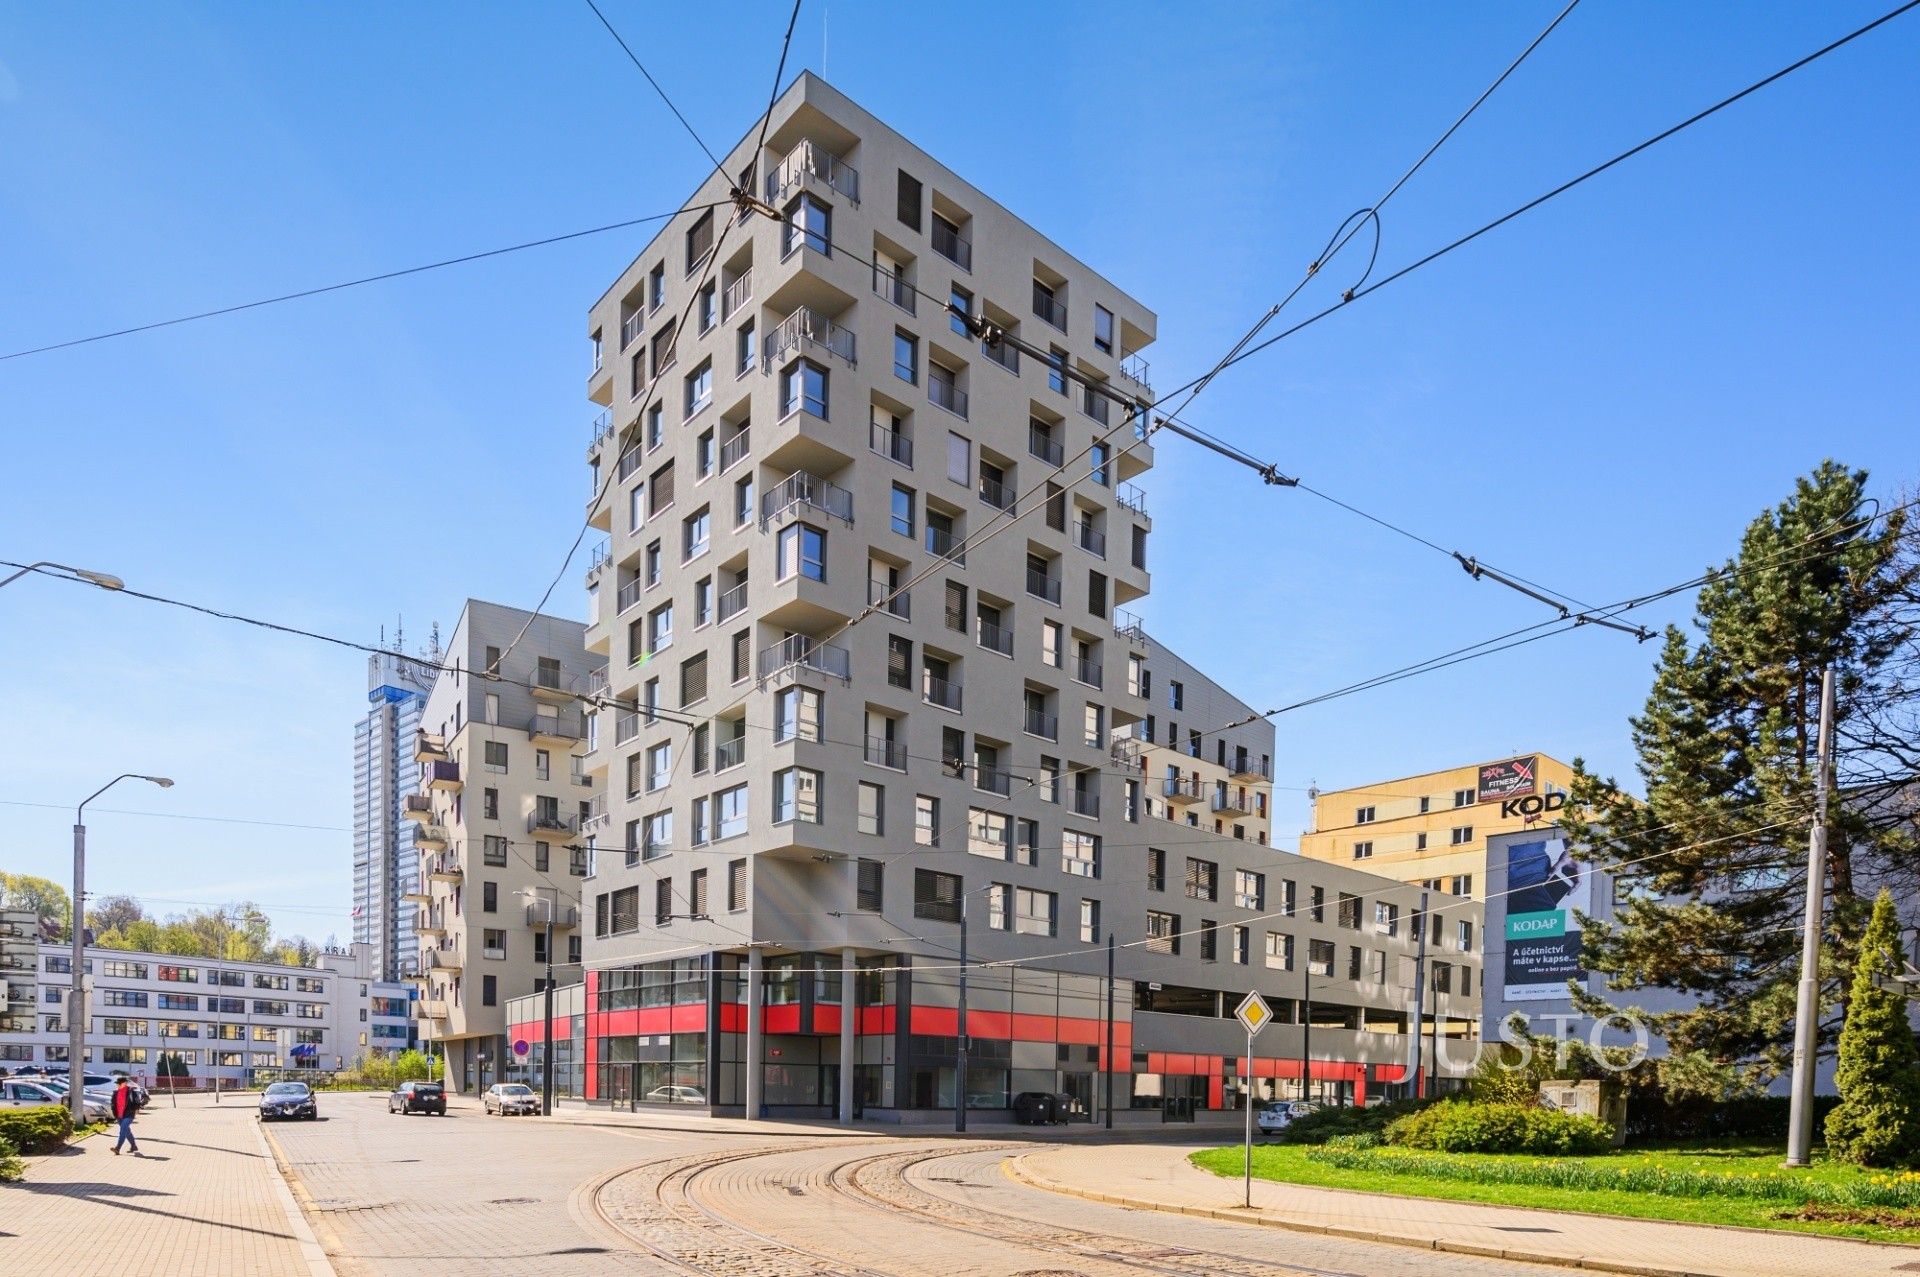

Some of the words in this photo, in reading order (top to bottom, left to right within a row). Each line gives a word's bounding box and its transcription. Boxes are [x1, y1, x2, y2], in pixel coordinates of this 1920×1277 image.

[1489, 777, 1519, 788] FITNESS
[1513, 918, 1558, 932] KODAP
[1521, 945, 1565, 956] účetnictví
[1513, 956, 1534, 965] máte
[1543, 955, 1578, 964] kapse...
